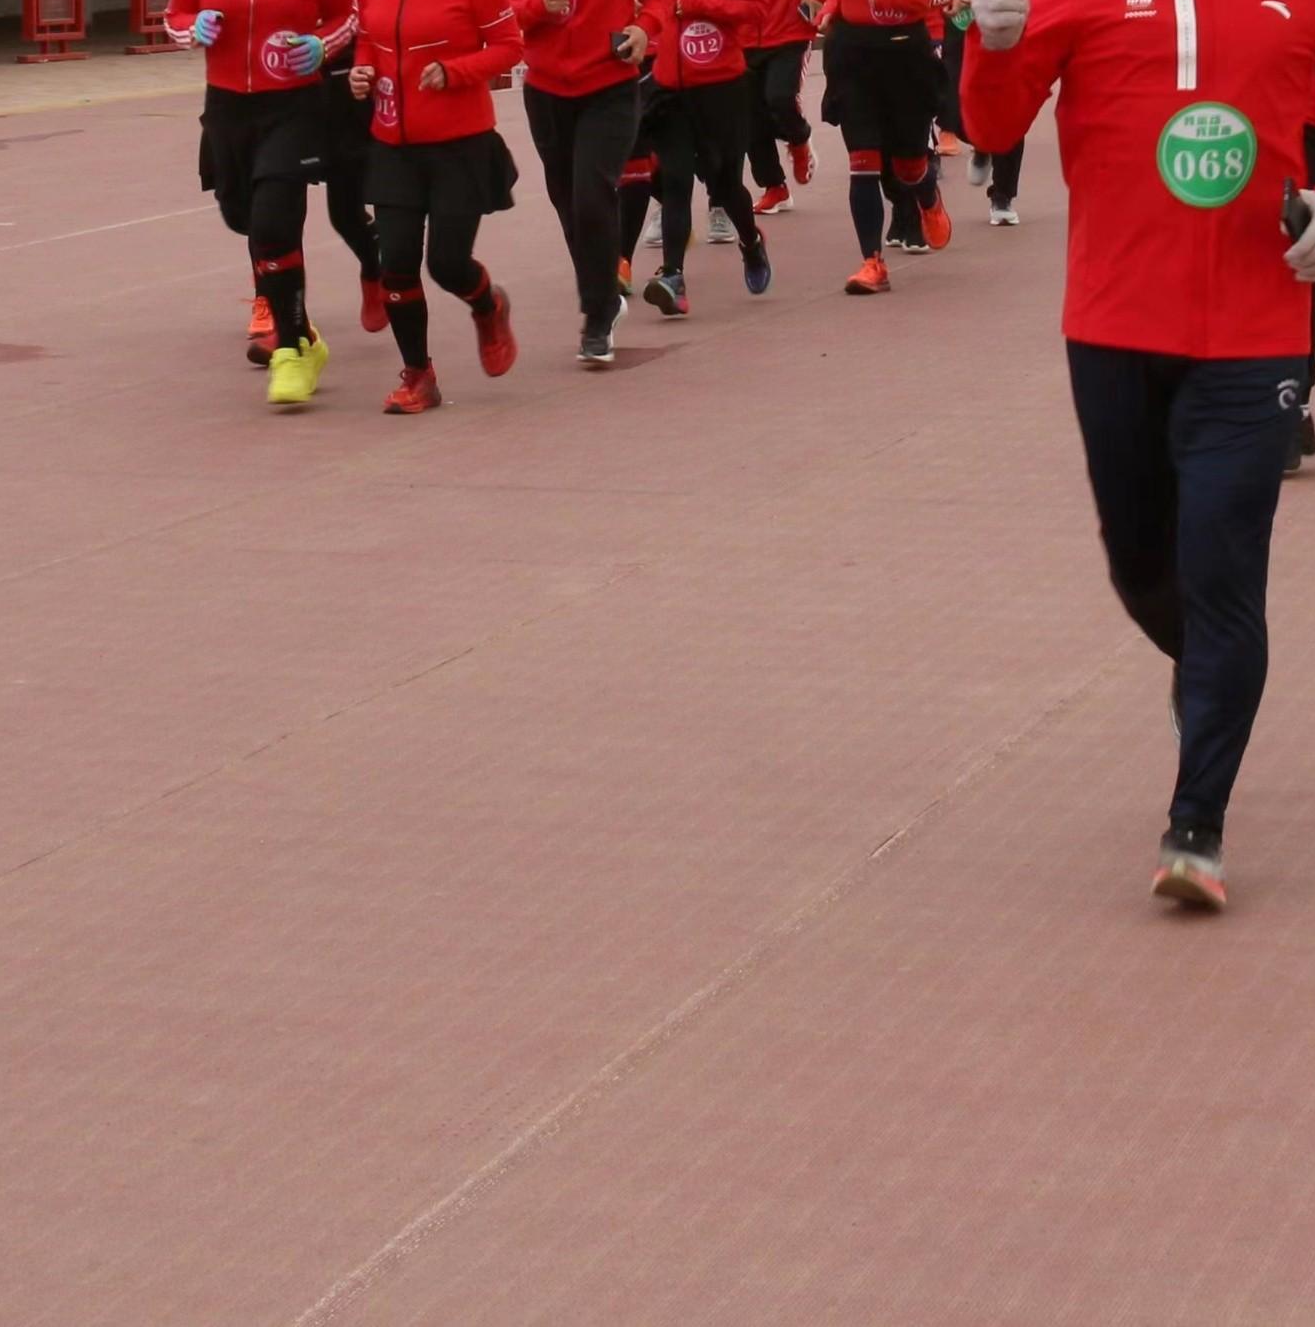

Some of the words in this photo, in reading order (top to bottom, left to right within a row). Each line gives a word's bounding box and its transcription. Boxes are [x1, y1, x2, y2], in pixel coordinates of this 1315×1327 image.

[686, 38, 719, 56] 012
[267, 51, 289, 69] 01
[1173, 147, 1245, 182] 068
